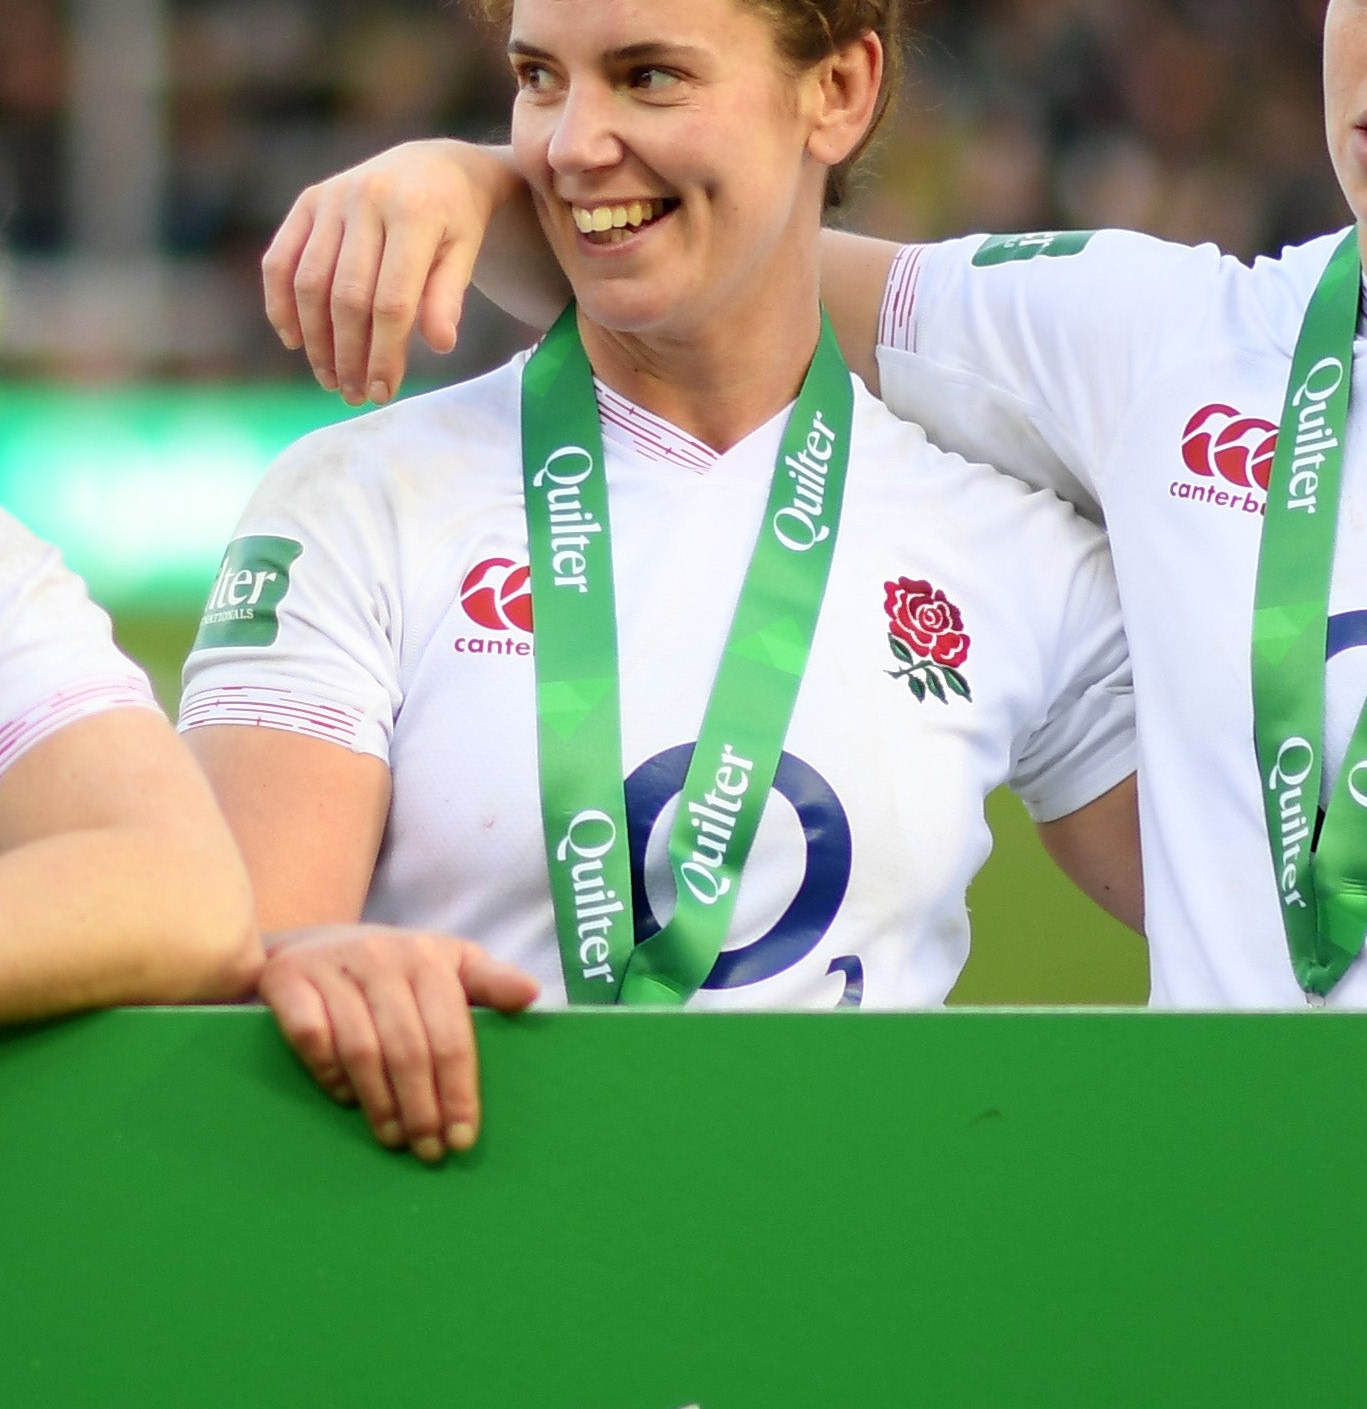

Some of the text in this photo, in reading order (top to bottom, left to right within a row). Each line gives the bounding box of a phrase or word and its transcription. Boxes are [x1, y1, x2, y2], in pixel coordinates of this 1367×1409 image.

[773, 410, 835, 551] Quilter
[1287, 357, 1343, 514] Quilter
[205, 556, 278, 611] lter
[533, 446, 602, 593] Quilter
[454, 637, 536, 657] cante
[557, 808, 625, 983] Quilter
[680, 744, 754, 905] Quilter
[1269, 736, 1315, 909] Quilter
